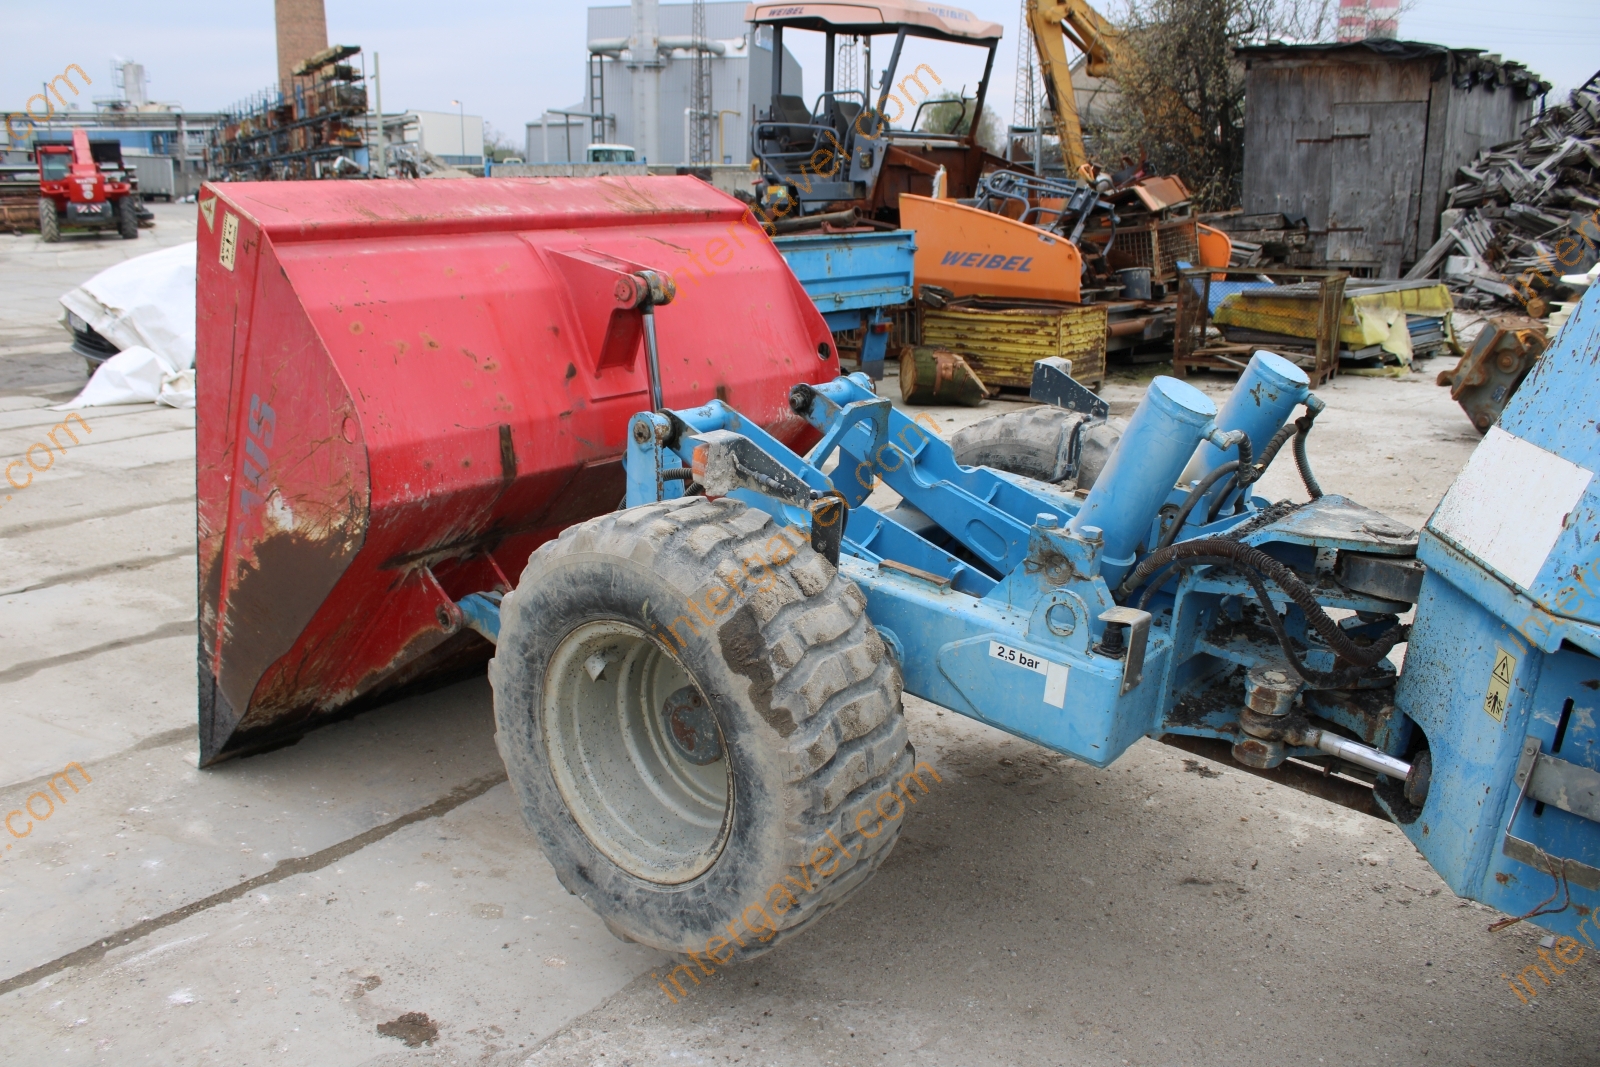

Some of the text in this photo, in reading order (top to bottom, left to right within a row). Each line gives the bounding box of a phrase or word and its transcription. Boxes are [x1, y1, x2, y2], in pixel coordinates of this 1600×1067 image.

[768, 6, 804, 17] WEIBEL
[927, 6, 971, 22] WEIBEL
[940, 250, 1034, 273] WEIBEL
[997, 646, 1040, 669] 2,5 bar
